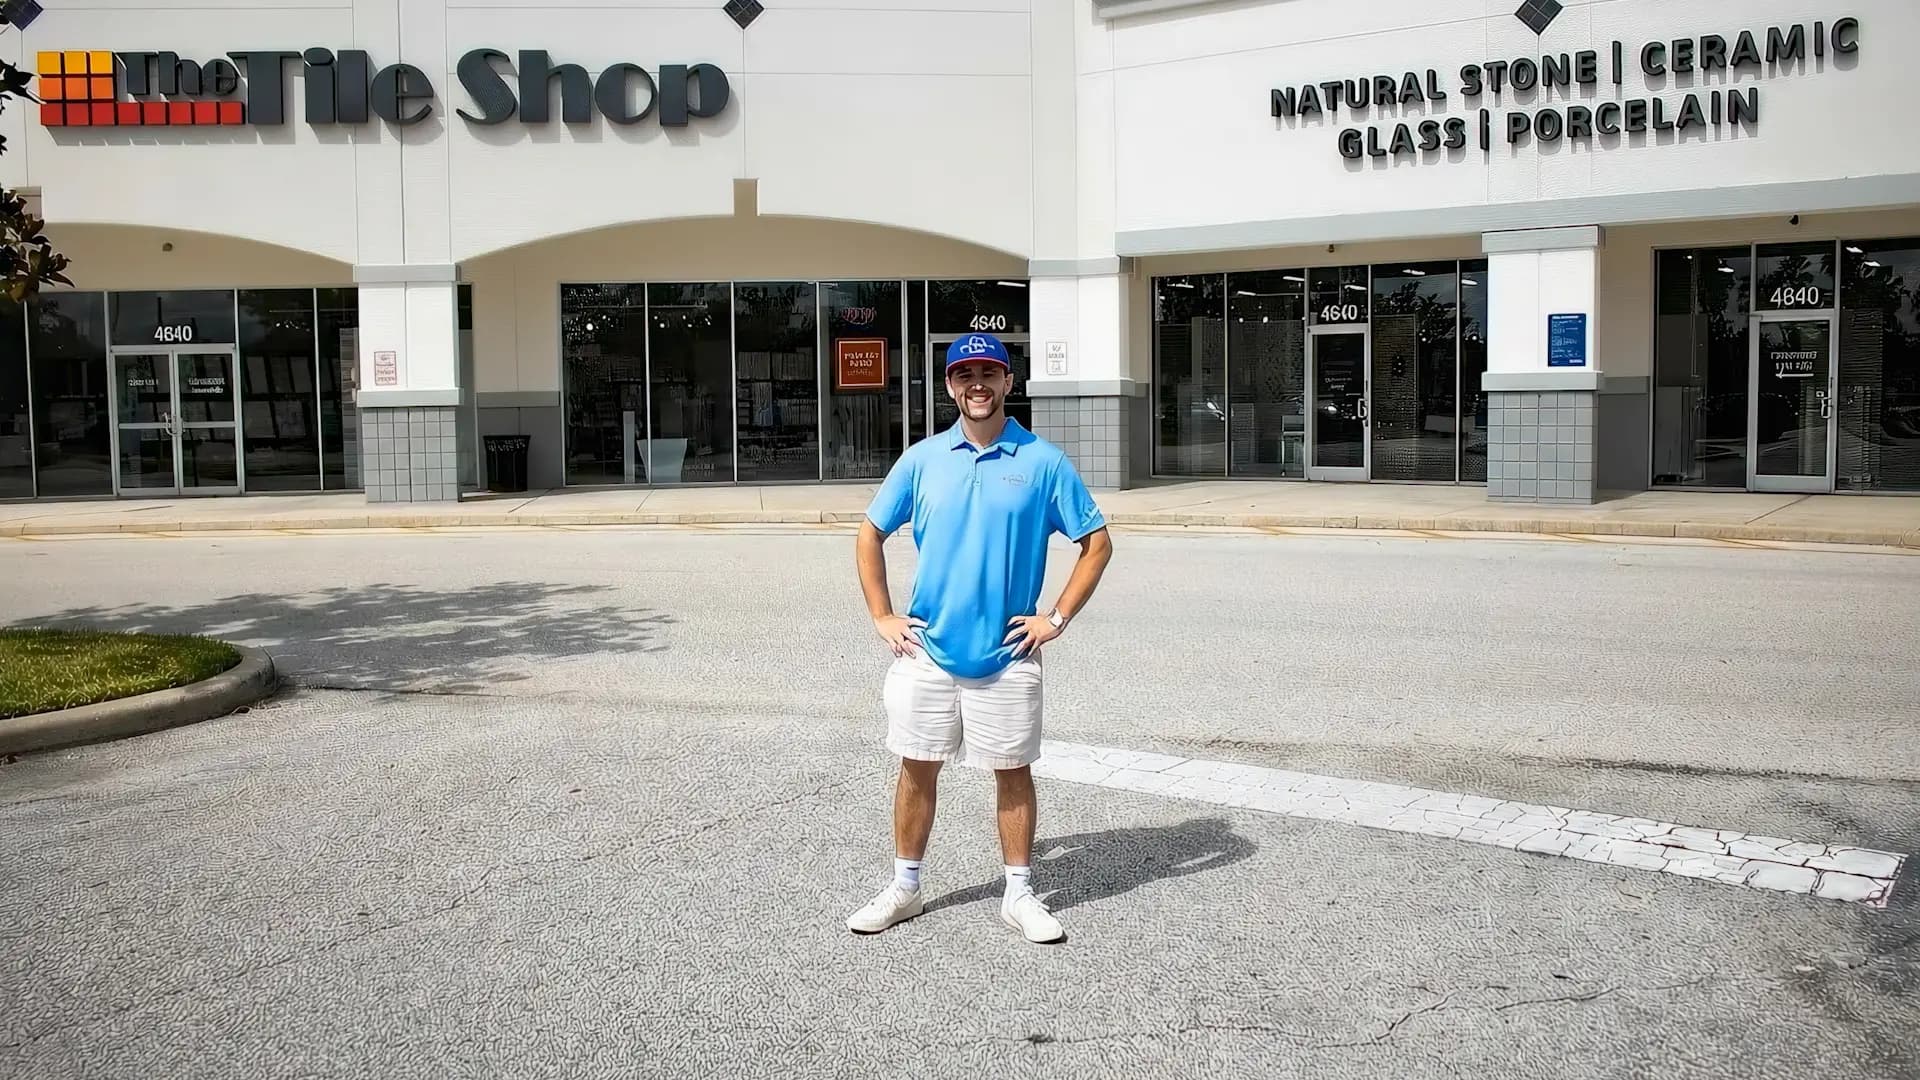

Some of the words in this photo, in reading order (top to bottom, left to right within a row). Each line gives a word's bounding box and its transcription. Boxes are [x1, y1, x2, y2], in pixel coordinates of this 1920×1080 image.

[114, 51, 238, 95] The
[226, 47, 434, 124] Tile
[456, 48, 730, 127] Shop
[1271, 69, 1447, 118] NATURAL
[1460, 50, 1597, 96] STONE
[1641, 17, 1859, 76] CERAMIC
[1338, 117, 1466, 159] GLASS
[1507, 87, 1758, 144] PORCELAIN
